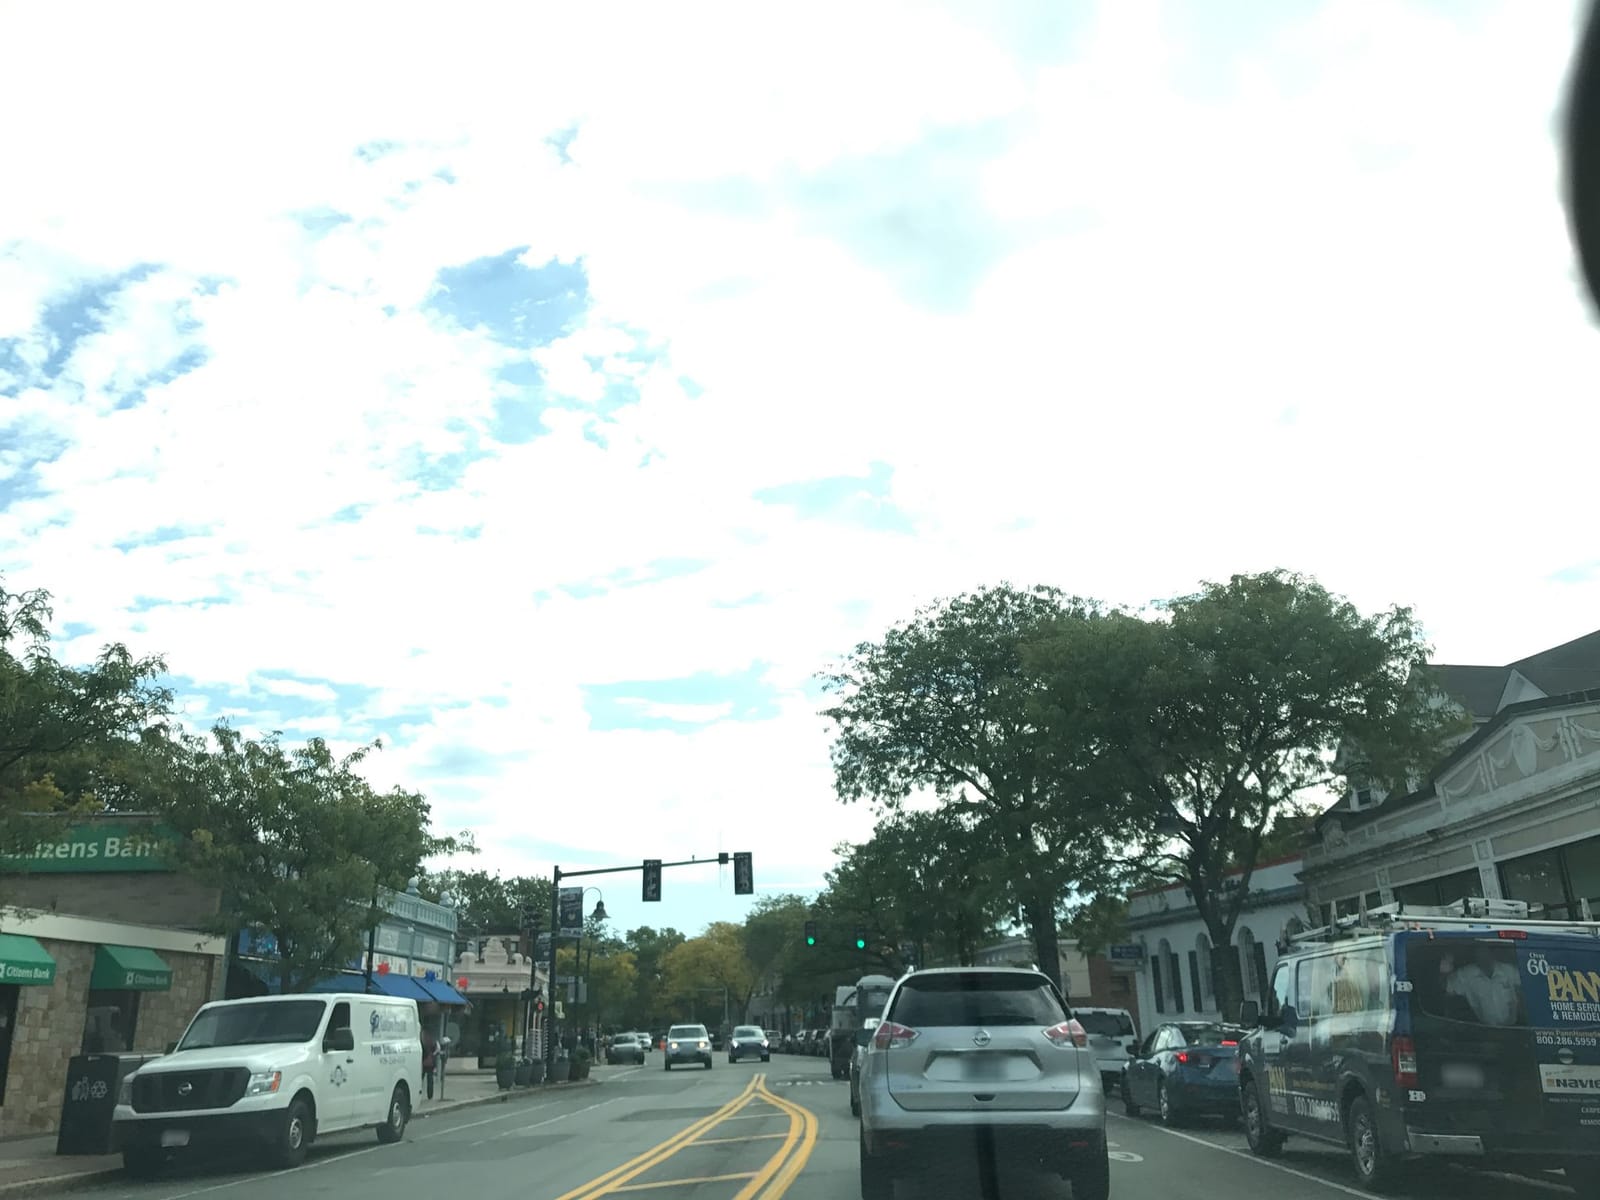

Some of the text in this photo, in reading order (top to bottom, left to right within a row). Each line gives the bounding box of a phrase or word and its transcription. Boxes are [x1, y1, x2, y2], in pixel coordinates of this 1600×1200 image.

[1, 839, 98, 859] izens
[1527, 958, 1549, 976] 60
[1550, 1002, 1576, 1011] HOME
[1552, 1011, 1560, 1020] &
[1536, 1036, 1597, 1046] 800.286.5959
